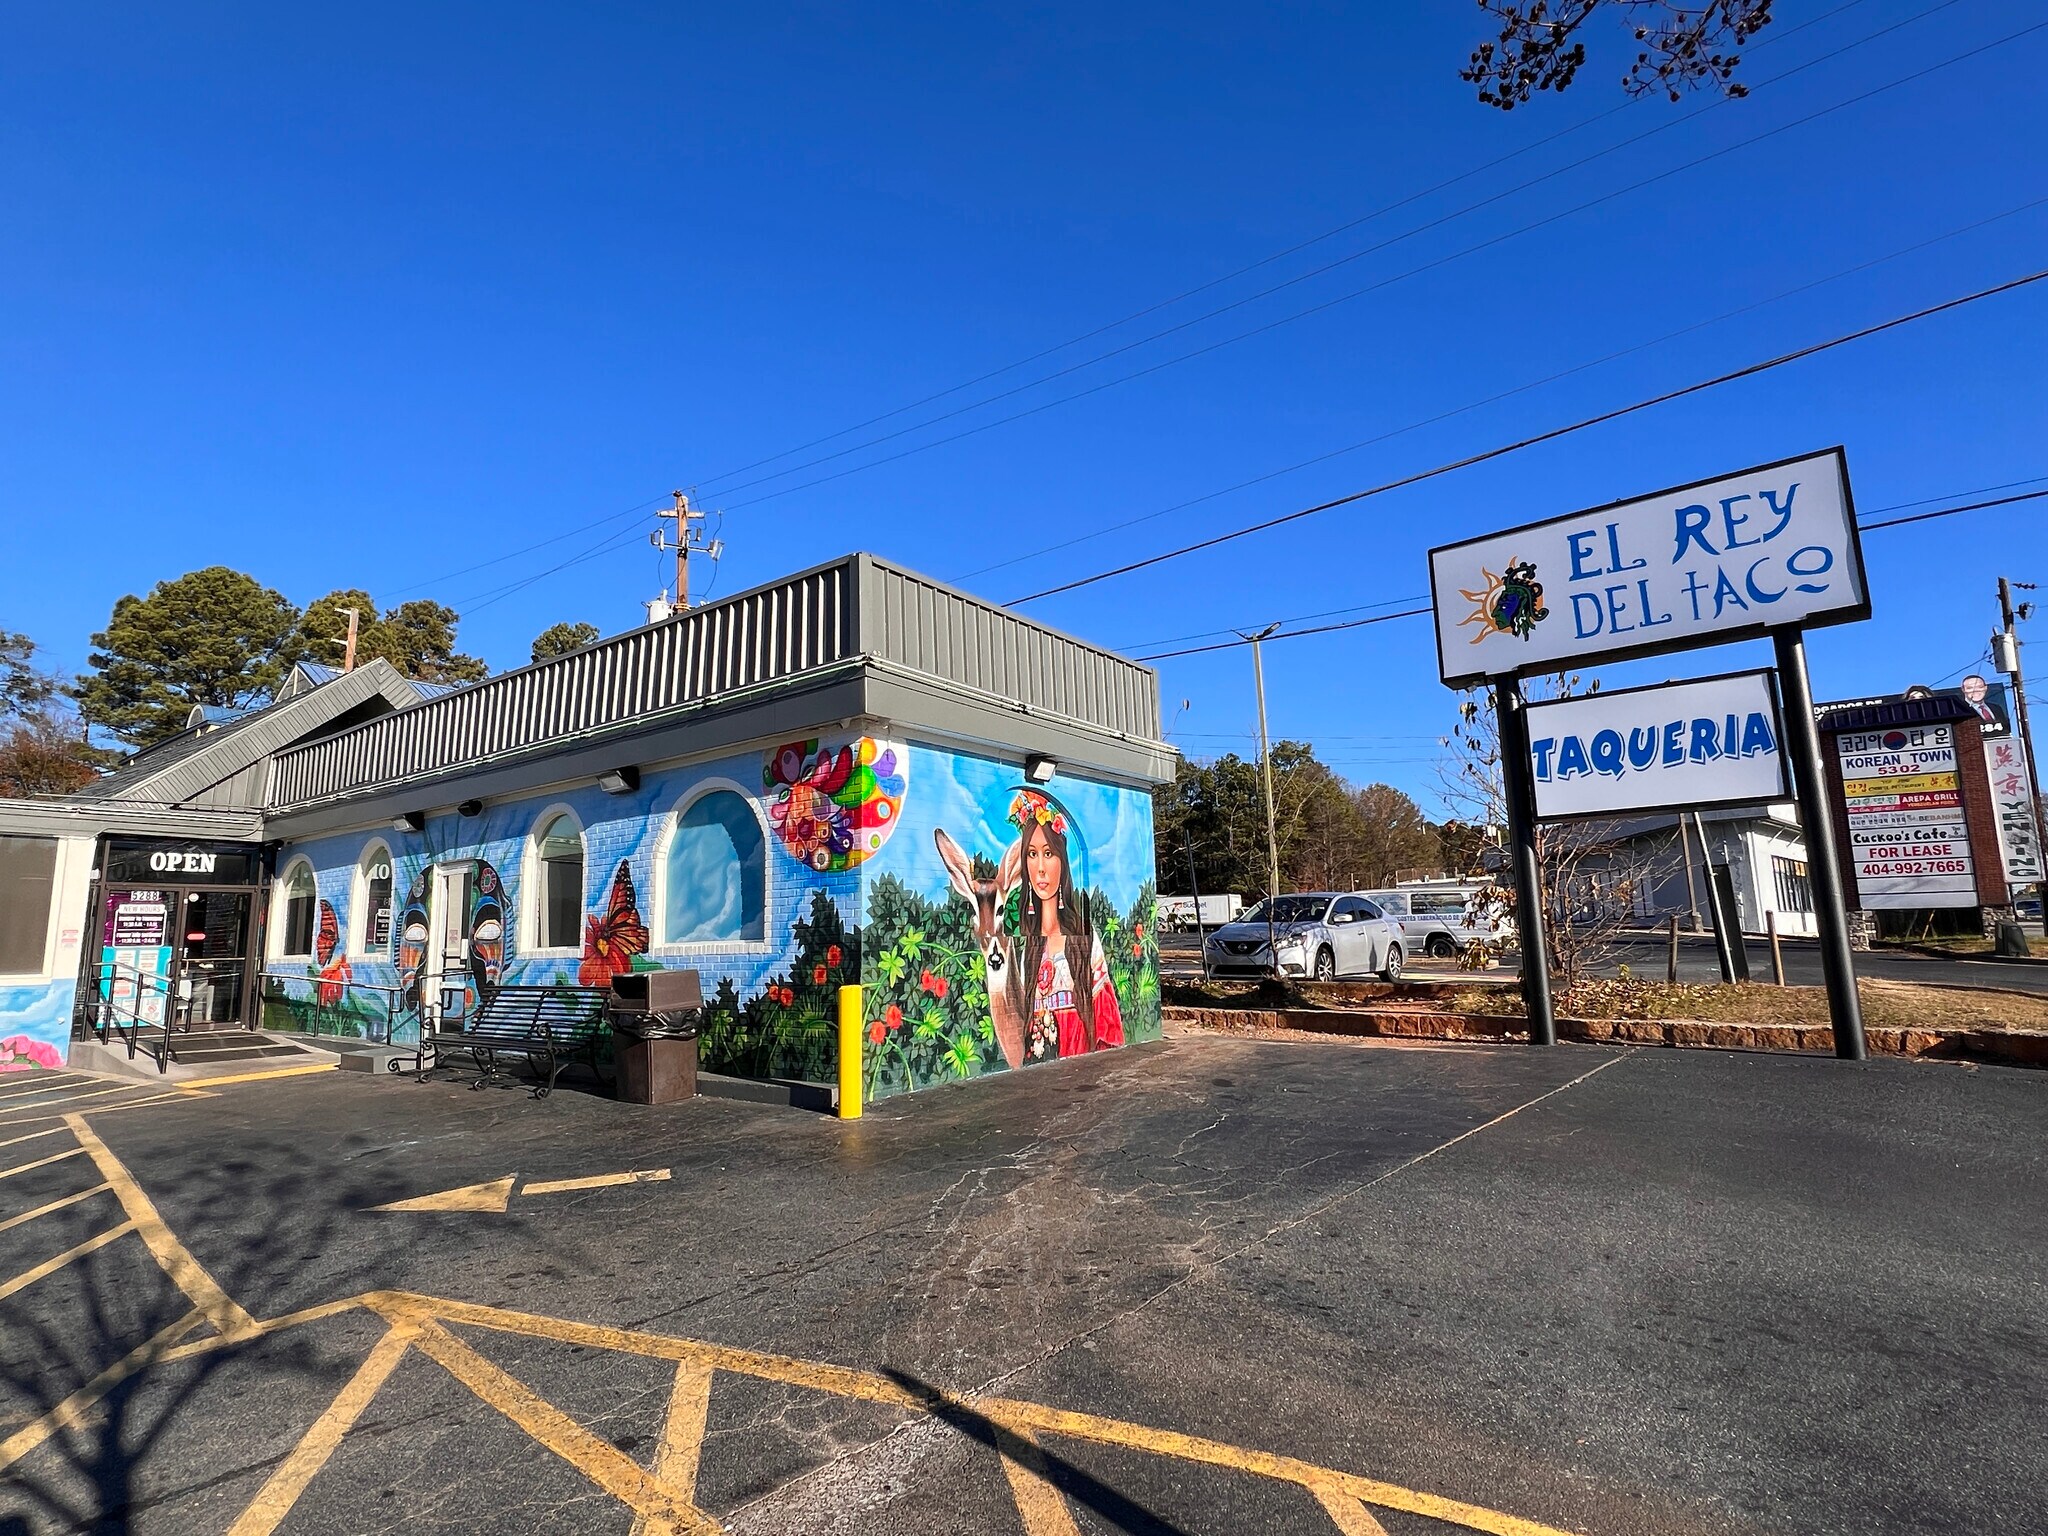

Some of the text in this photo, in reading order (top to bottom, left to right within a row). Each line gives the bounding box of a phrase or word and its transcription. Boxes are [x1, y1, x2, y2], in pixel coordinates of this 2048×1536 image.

[1567, 482, 1801, 582] EL REY
[1570, 546, 1834, 640] DEL TACO
[1532, 711, 1777, 782] TAQUERIA
[1841, 734, 1882, 753] 코리아
[1846, 750, 1952, 769] KOREAN TOWN
[1878, 764, 1920, 775] 5302
[1902, 794, 1931, 804] AREPA
[1933, 793, 1959, 802] GRILL
[1853, 828, 1947, 844] Cuckoo's Cafe
[1869, 844, 1953, 859] FOR LEASE
[150, 852, 217, 873] OPEN
[1863, 860, 1965, 875] 404-992-7665
[132, 891, 159, 900] 5288
